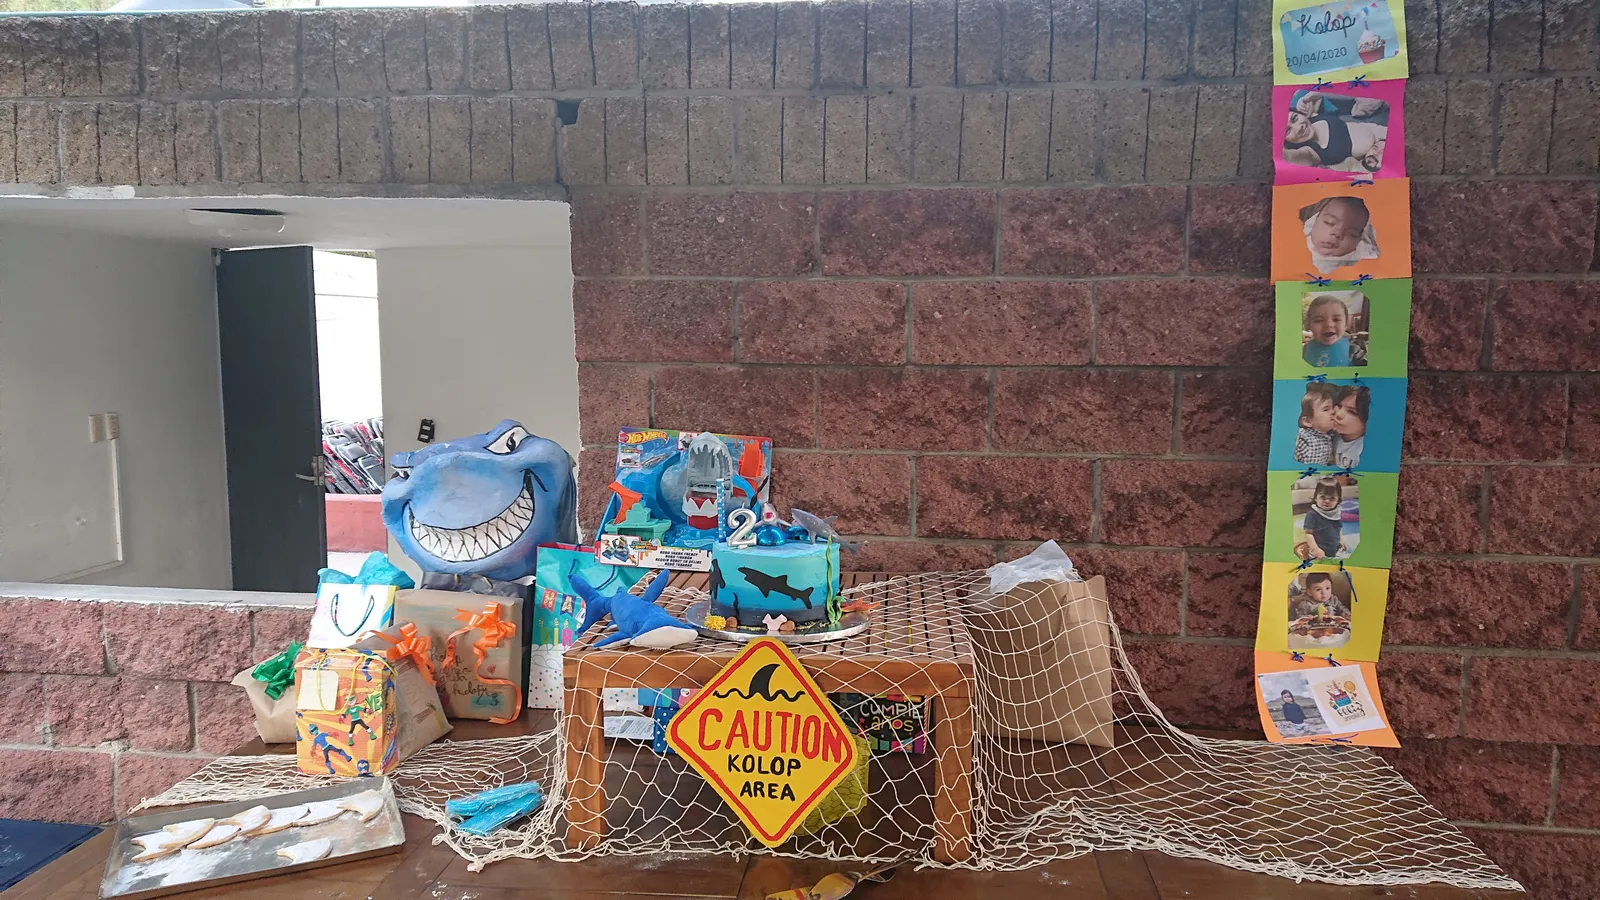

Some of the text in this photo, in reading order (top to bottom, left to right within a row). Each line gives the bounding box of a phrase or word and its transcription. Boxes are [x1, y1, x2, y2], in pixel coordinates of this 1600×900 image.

[1297, 11, 1356, 38] Kolop
[1286, 47, 1348, 67] 20/04/2020
[727, 508, 757, 547] 2
[699, 708, 842, 763] CAUTION
[728, 754, 802, 777] KOLOP
[740, 780, 796, 802] AREA
